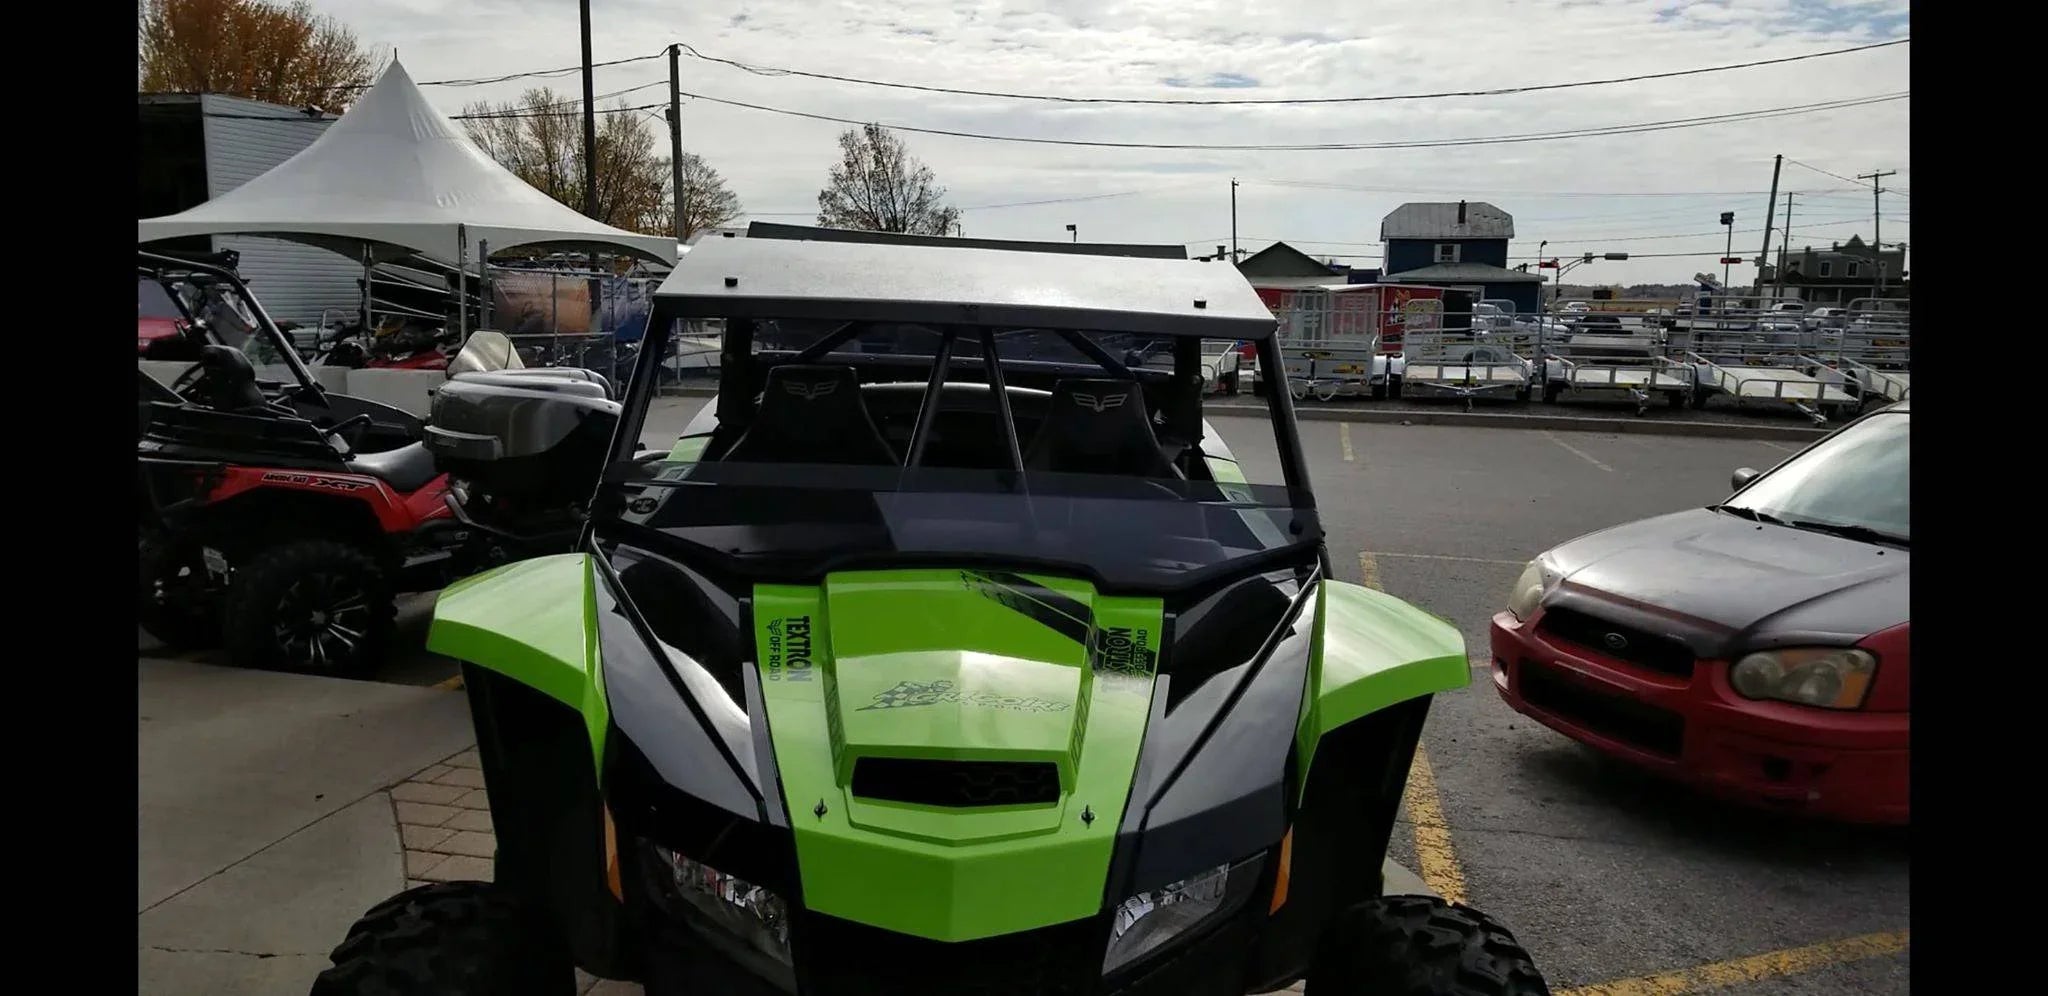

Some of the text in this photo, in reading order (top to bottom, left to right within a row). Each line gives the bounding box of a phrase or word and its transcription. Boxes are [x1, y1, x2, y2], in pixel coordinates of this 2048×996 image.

[769, 636, 782, 682] OFF ROAD
[786, 615, 812, 682] TEXTRON
[1102, 627, 1132, 693] TXTRON
